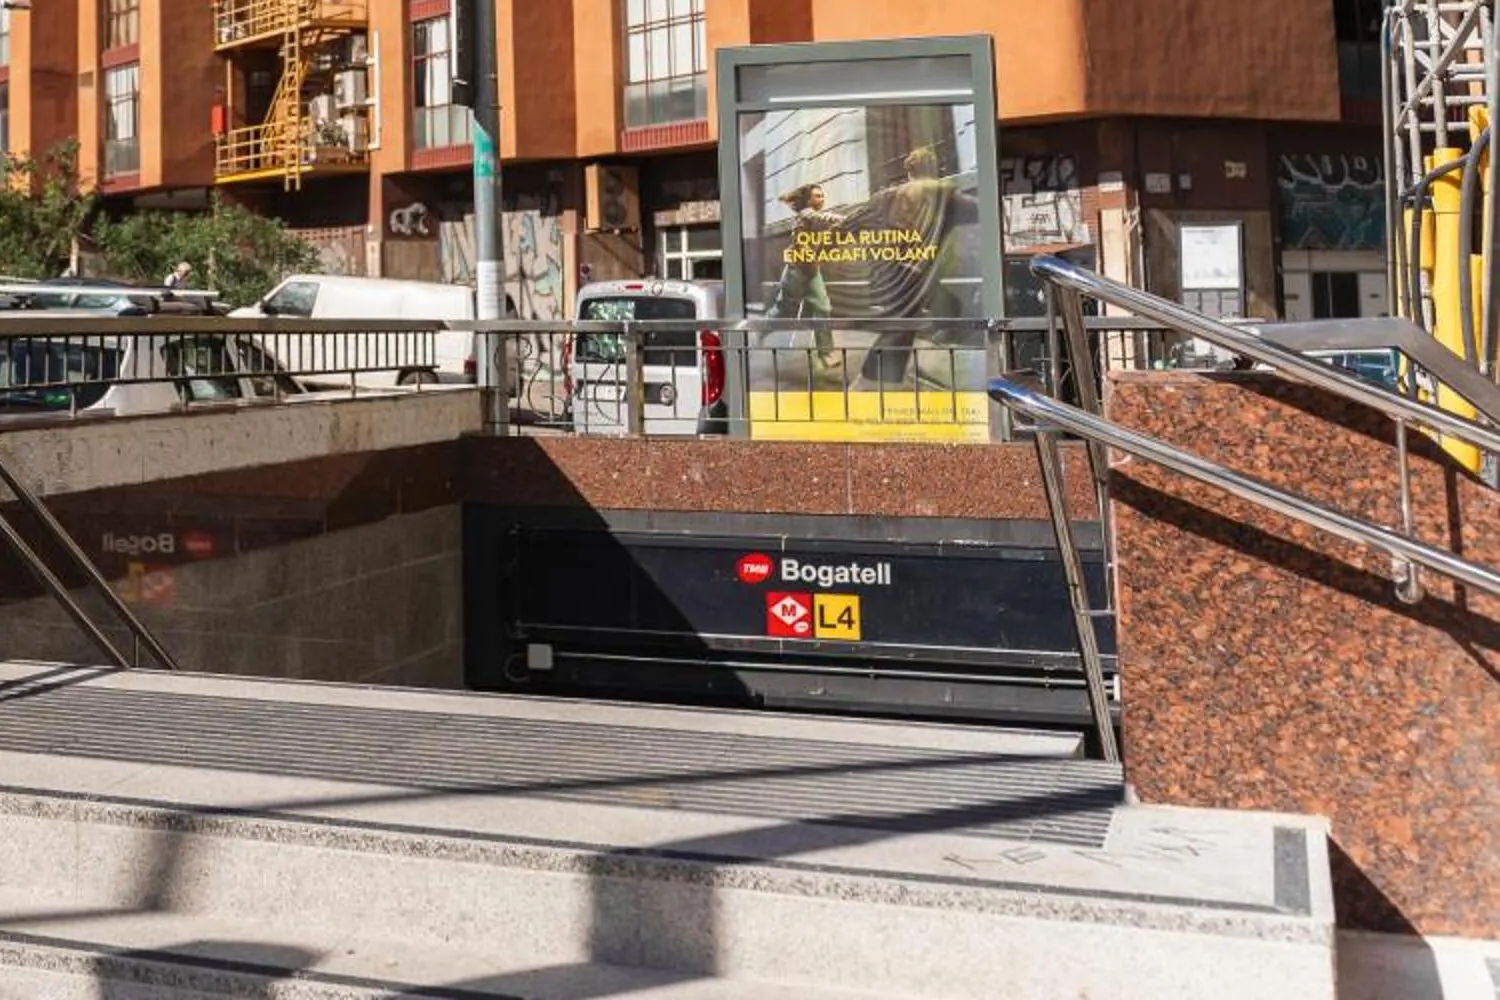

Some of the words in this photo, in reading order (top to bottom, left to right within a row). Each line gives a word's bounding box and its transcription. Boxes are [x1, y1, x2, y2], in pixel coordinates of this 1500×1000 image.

[797, 231, 832, 246] QUE
[836, 231, 856, 245] LA
[859, 229, 922, 244] RUTINA
[783, 249, 814, 263] ENS
[817, 247, 867, 262] AGAFI
[869, 245, 938, 262] VOLANT
[781, 558, 891, 587] Bogatell
[781, 604, 797, 617] M
[819, 604, 855, 630] L4
